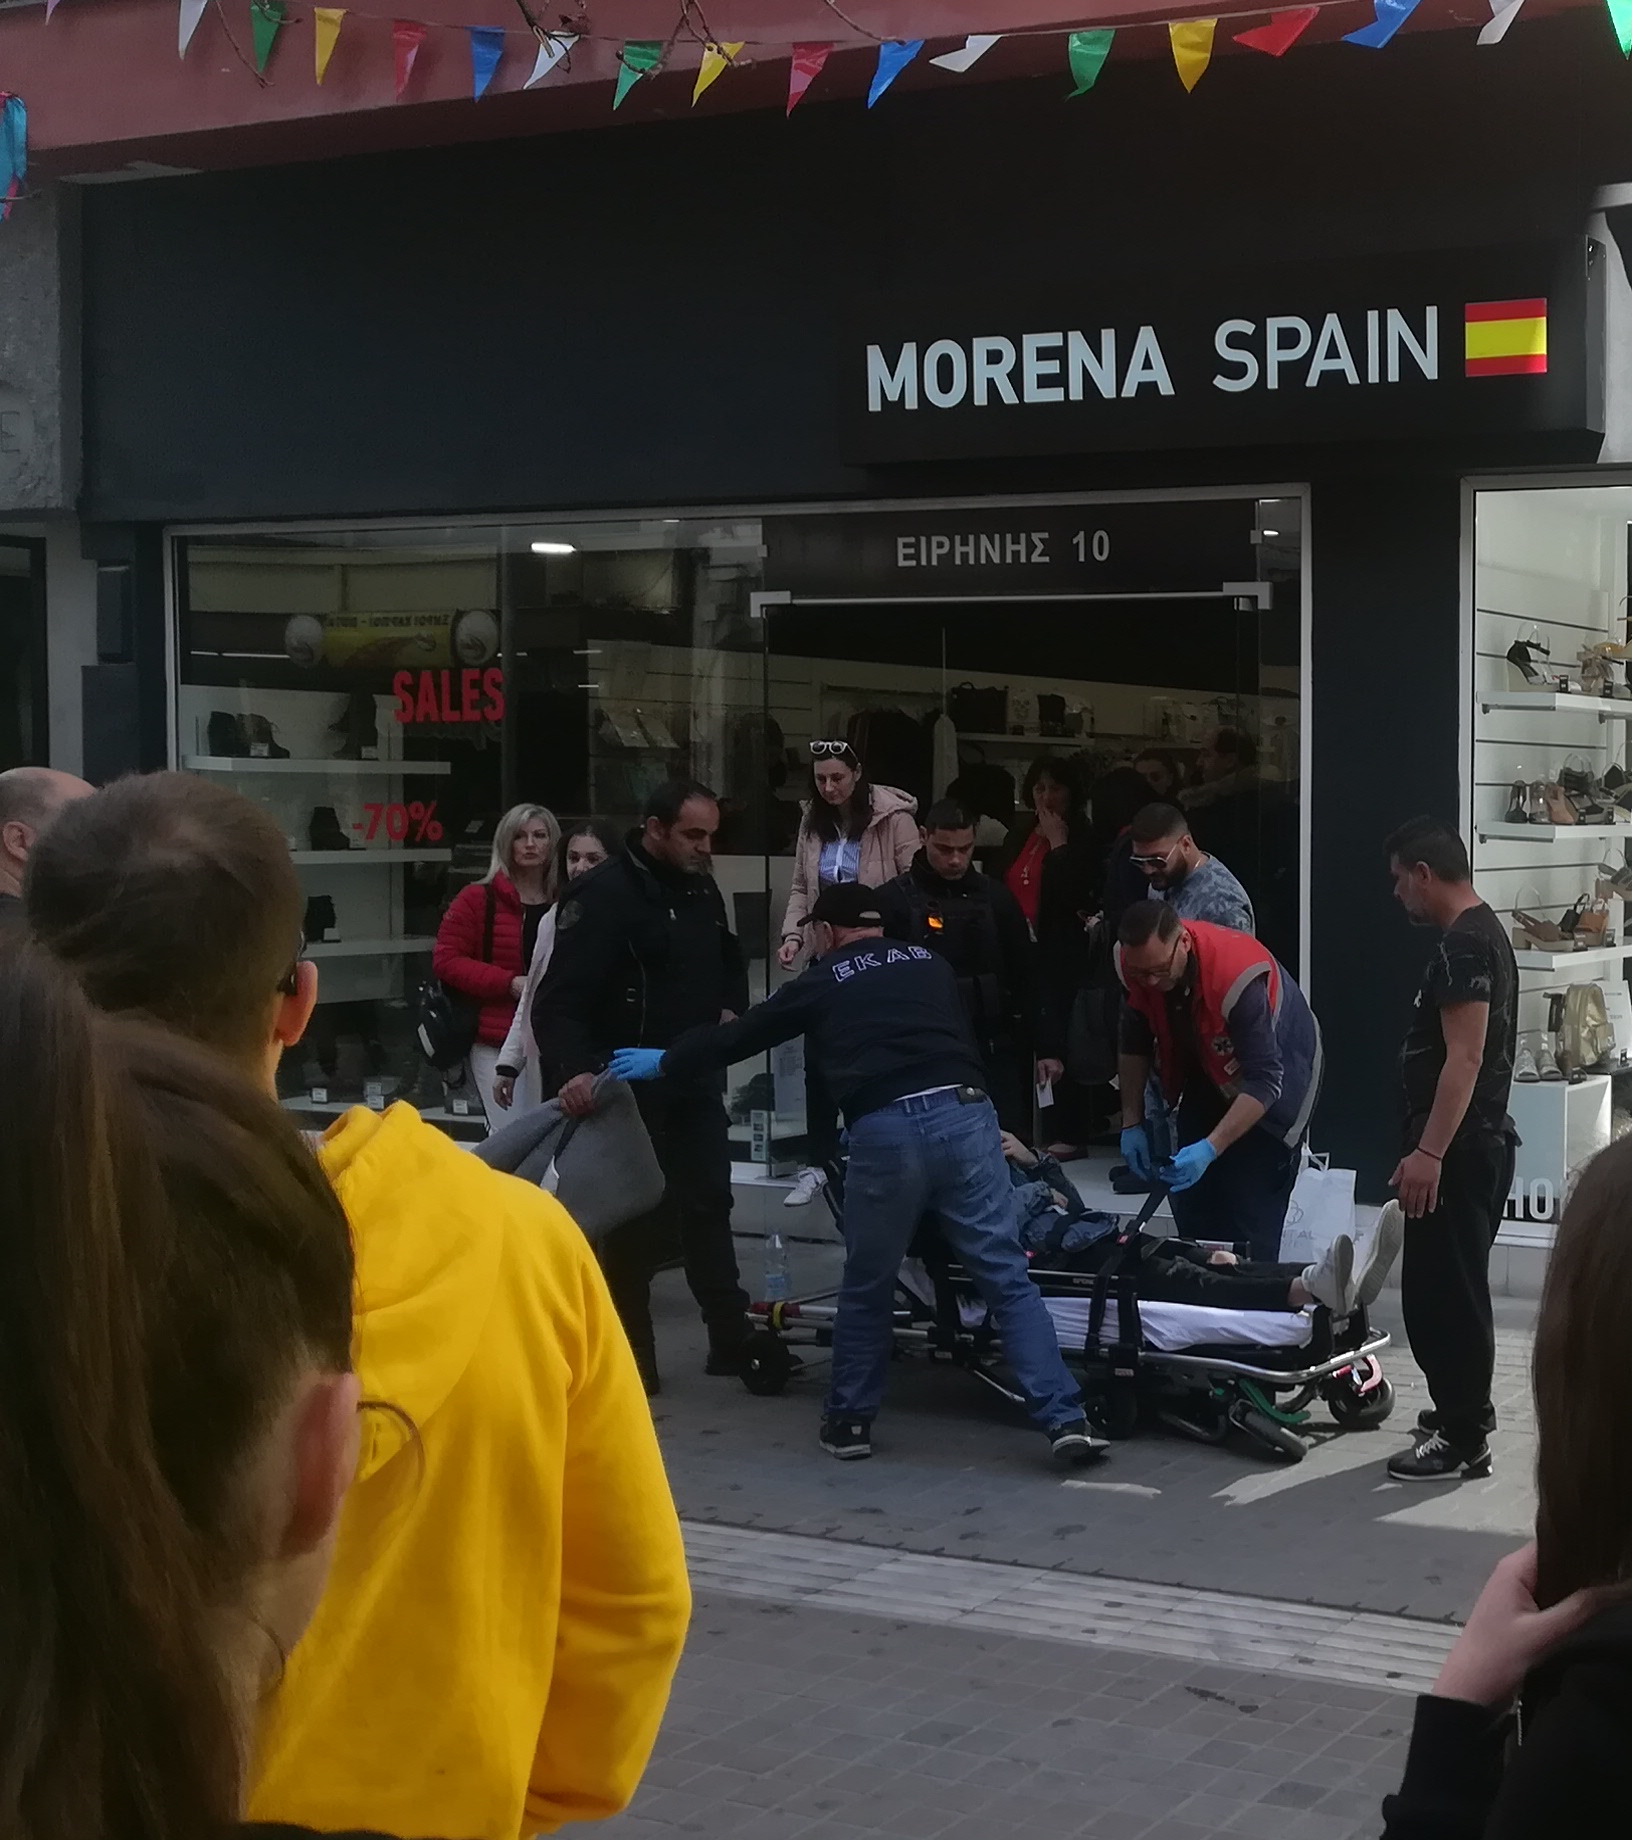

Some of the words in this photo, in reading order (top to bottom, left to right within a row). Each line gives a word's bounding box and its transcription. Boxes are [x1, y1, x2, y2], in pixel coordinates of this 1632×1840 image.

[866, 325, 1175, 411] MORENA
[1212, 305, 1440, 392] SPAIN
[896, 530, 1050, 567] ΕΙΡΗΝΗΣ
[1071, 530, 1111, 563] 10
[393, 667, 505, 723] SALES
[352, 801, 444, 842] -70%
[832, 946, 932, 982] ΕΚΑΒ
